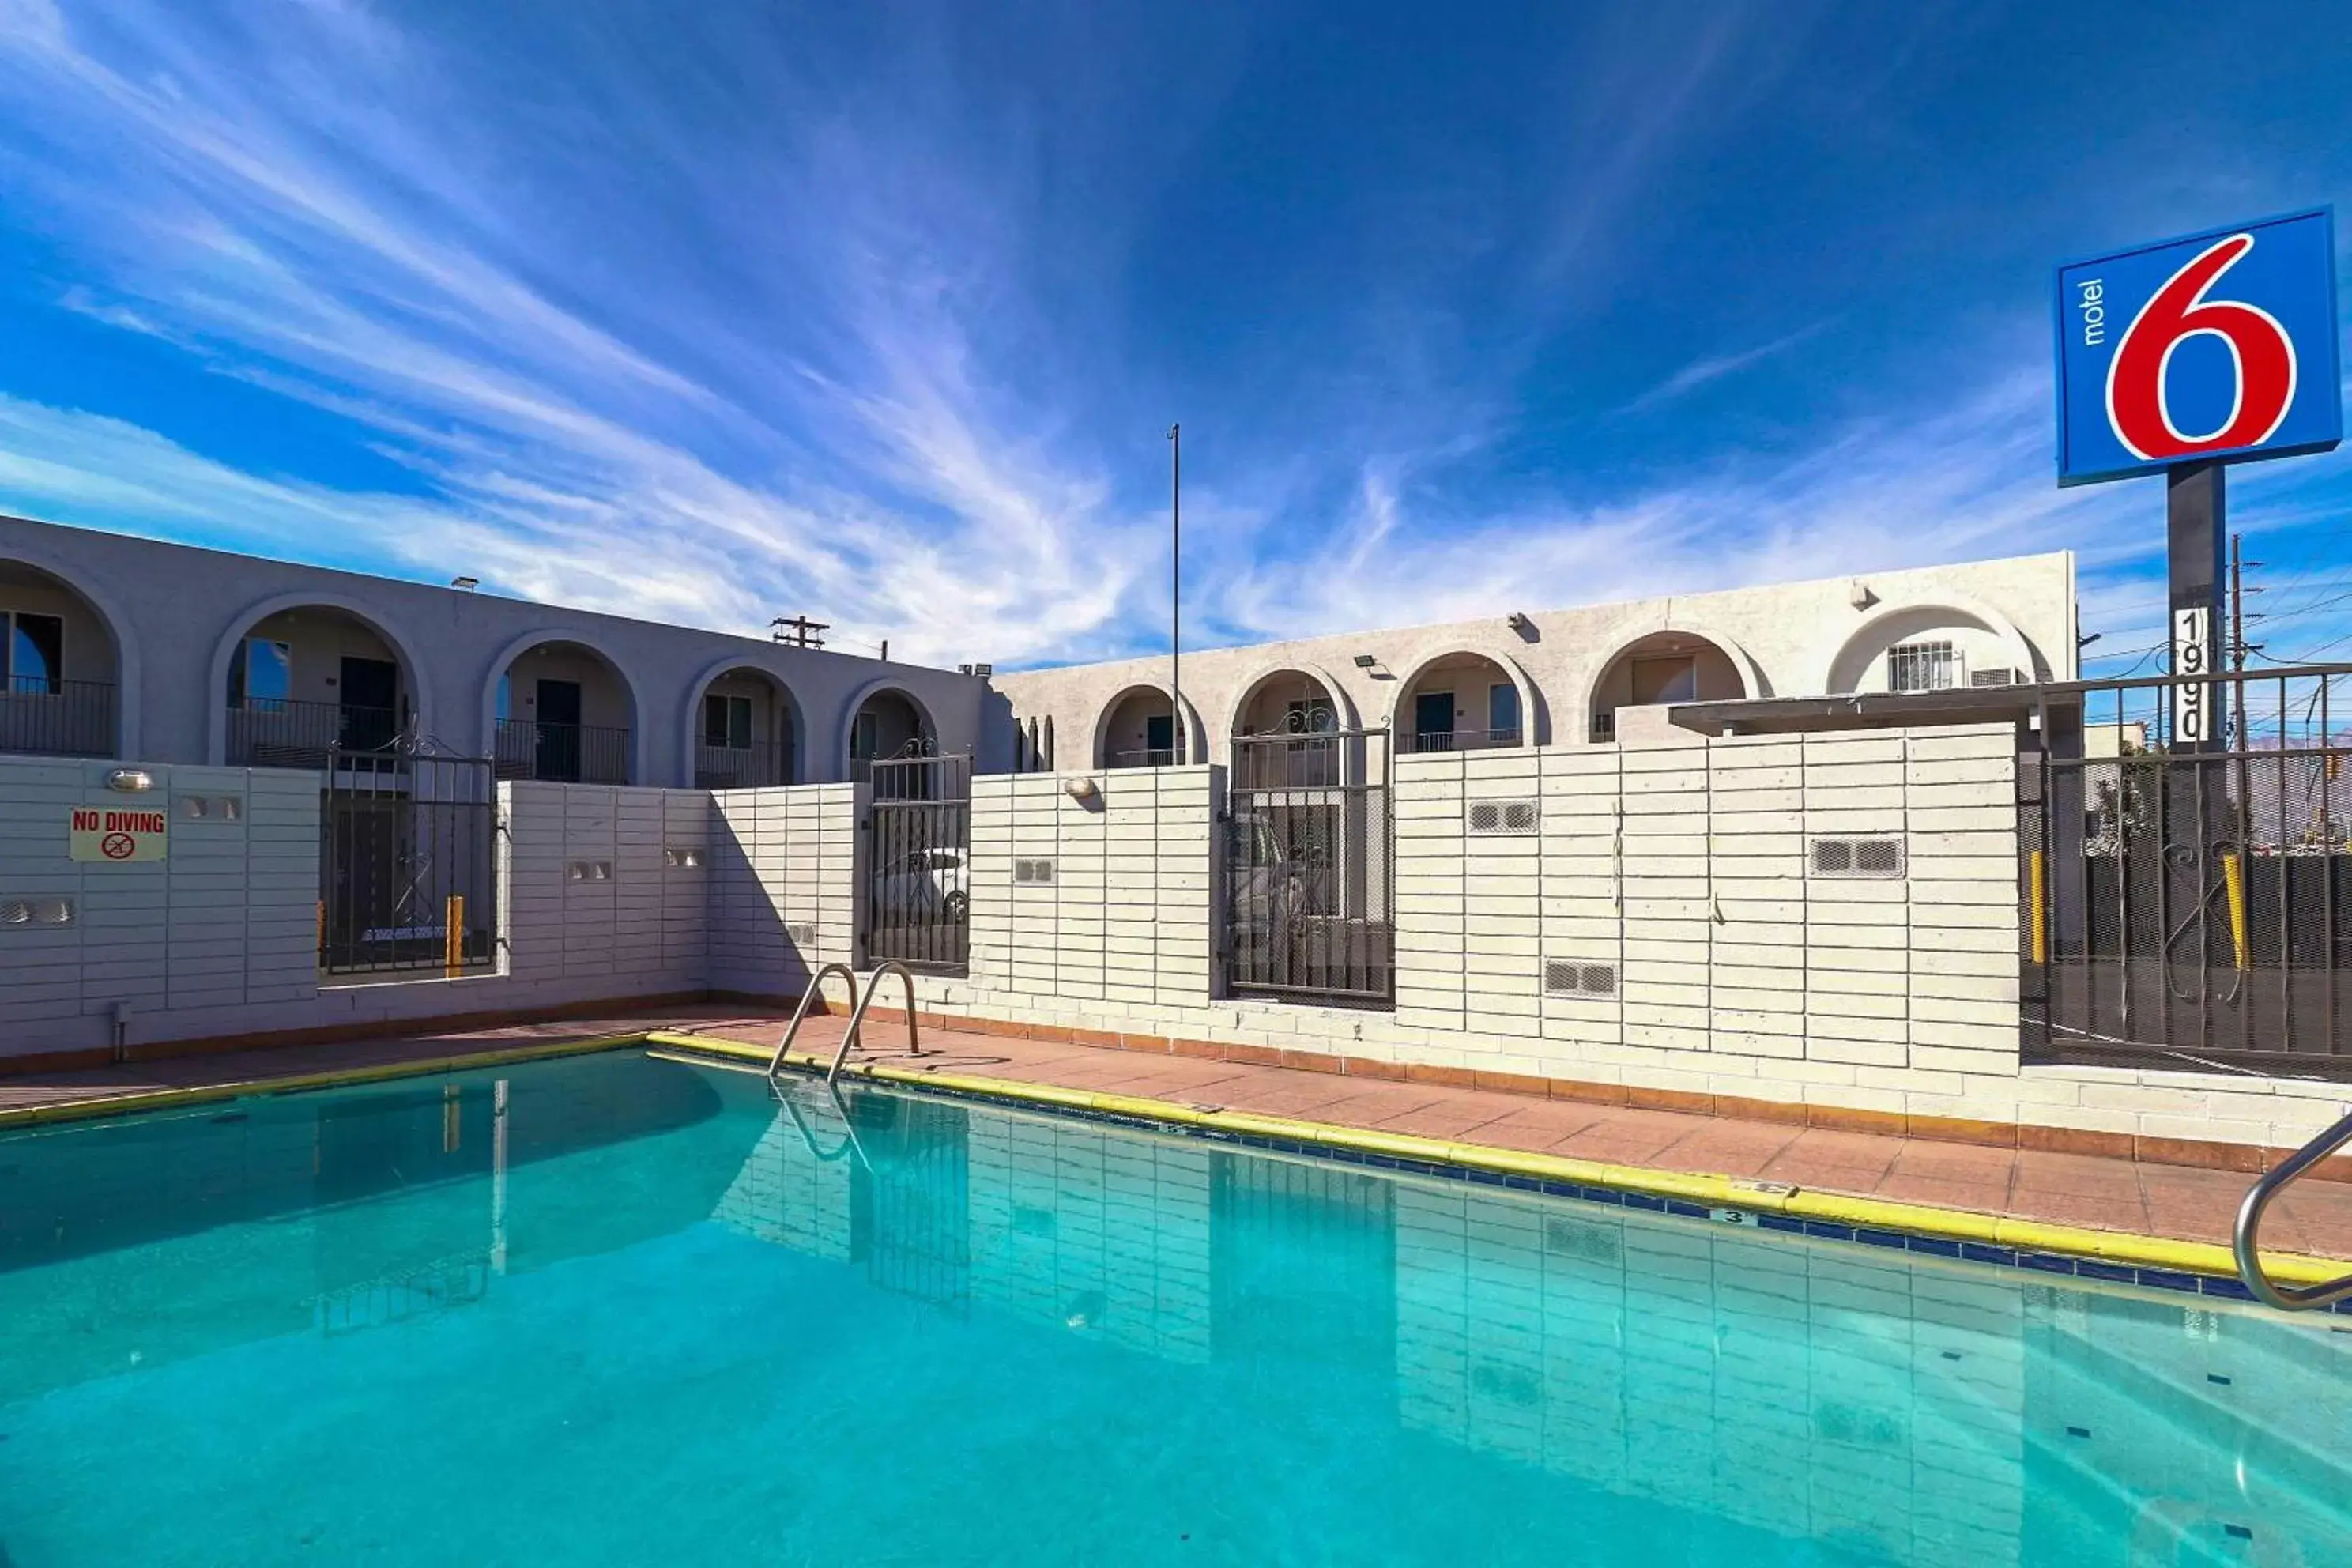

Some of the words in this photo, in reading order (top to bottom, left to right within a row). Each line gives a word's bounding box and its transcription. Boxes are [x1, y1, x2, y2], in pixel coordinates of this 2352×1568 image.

[2077, 278, 2104, 346] motel
[2105, 233, 2297, 460] 6
[2182, 612, 2202, 738] 1990
[74, 811, 99, 831] NO
[106, 812, 164, 833] DIVING
[1725, 1211, 1743, 1223] 3
